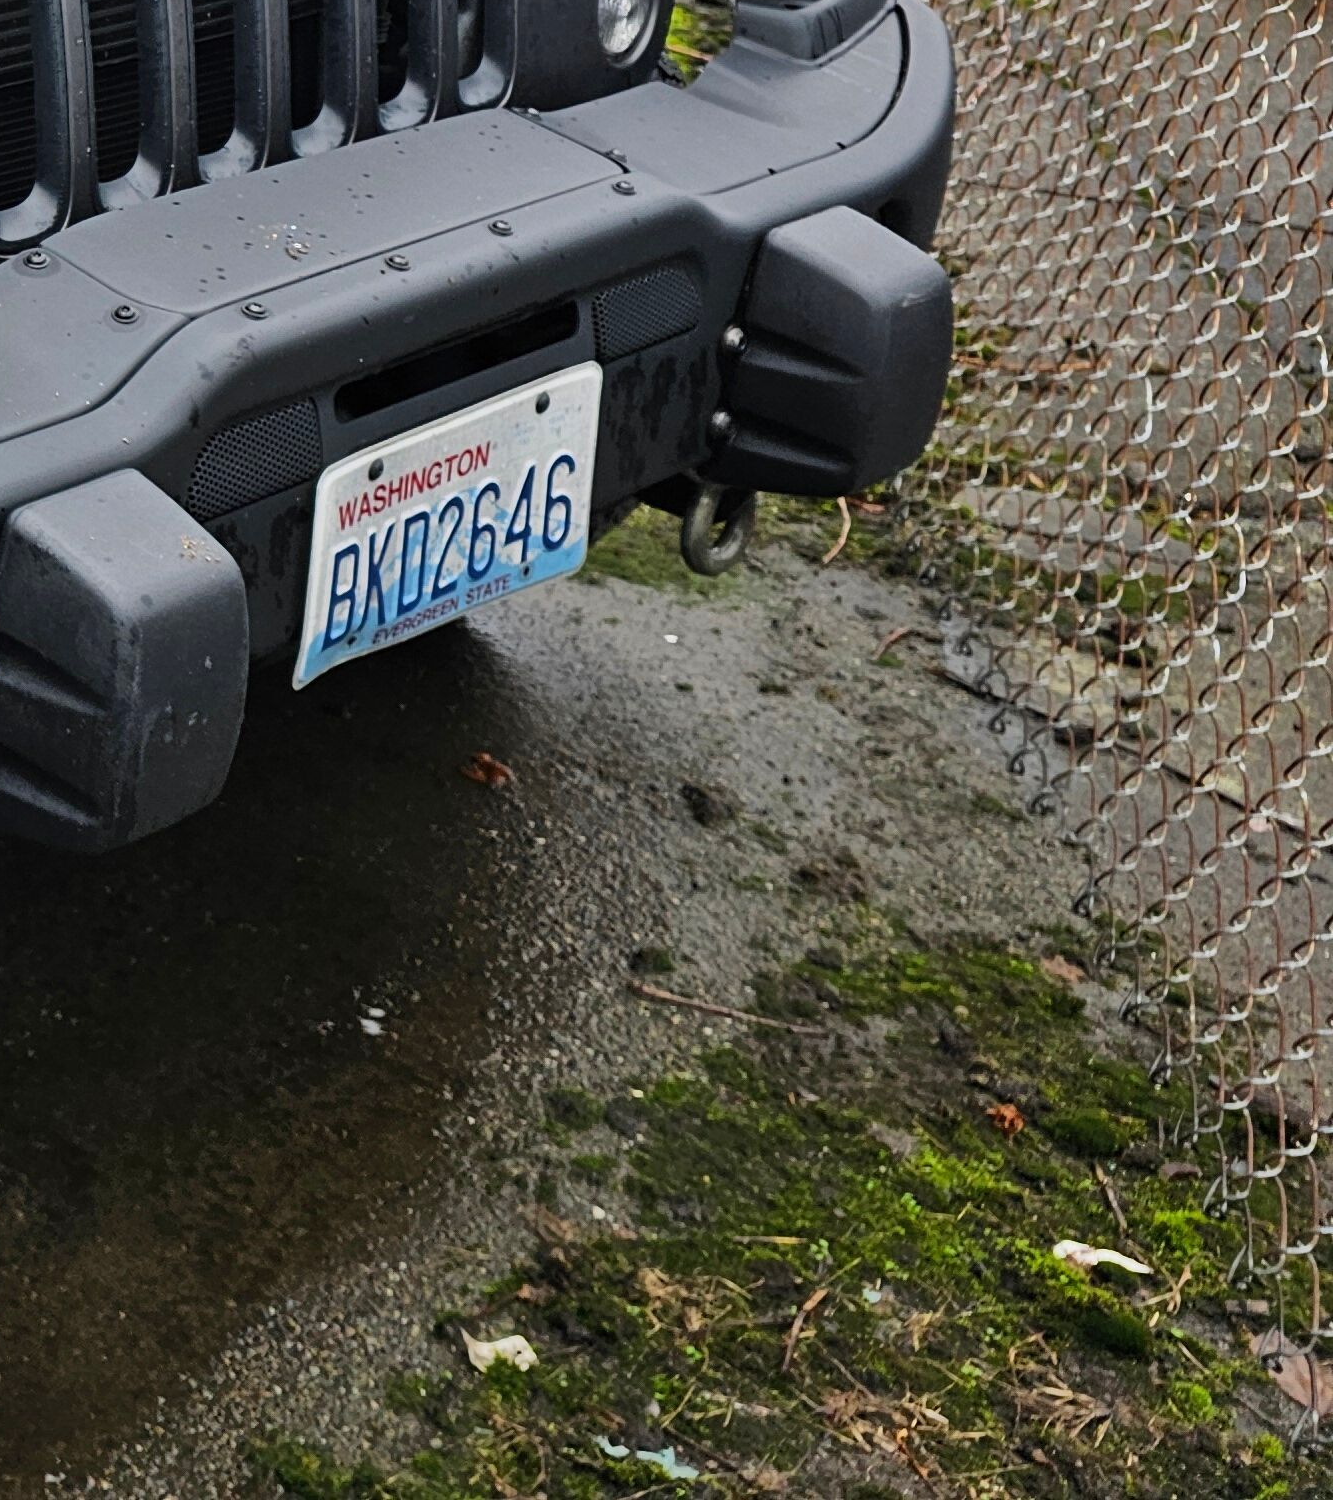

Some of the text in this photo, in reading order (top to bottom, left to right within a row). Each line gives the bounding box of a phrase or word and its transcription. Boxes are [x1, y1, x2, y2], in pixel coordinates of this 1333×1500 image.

[338, 441, 491, 531] WASHINGTON
[321, 453, 576, 653] BKD2646
[372, 573, 512, 645] EVERGREEN STATE
